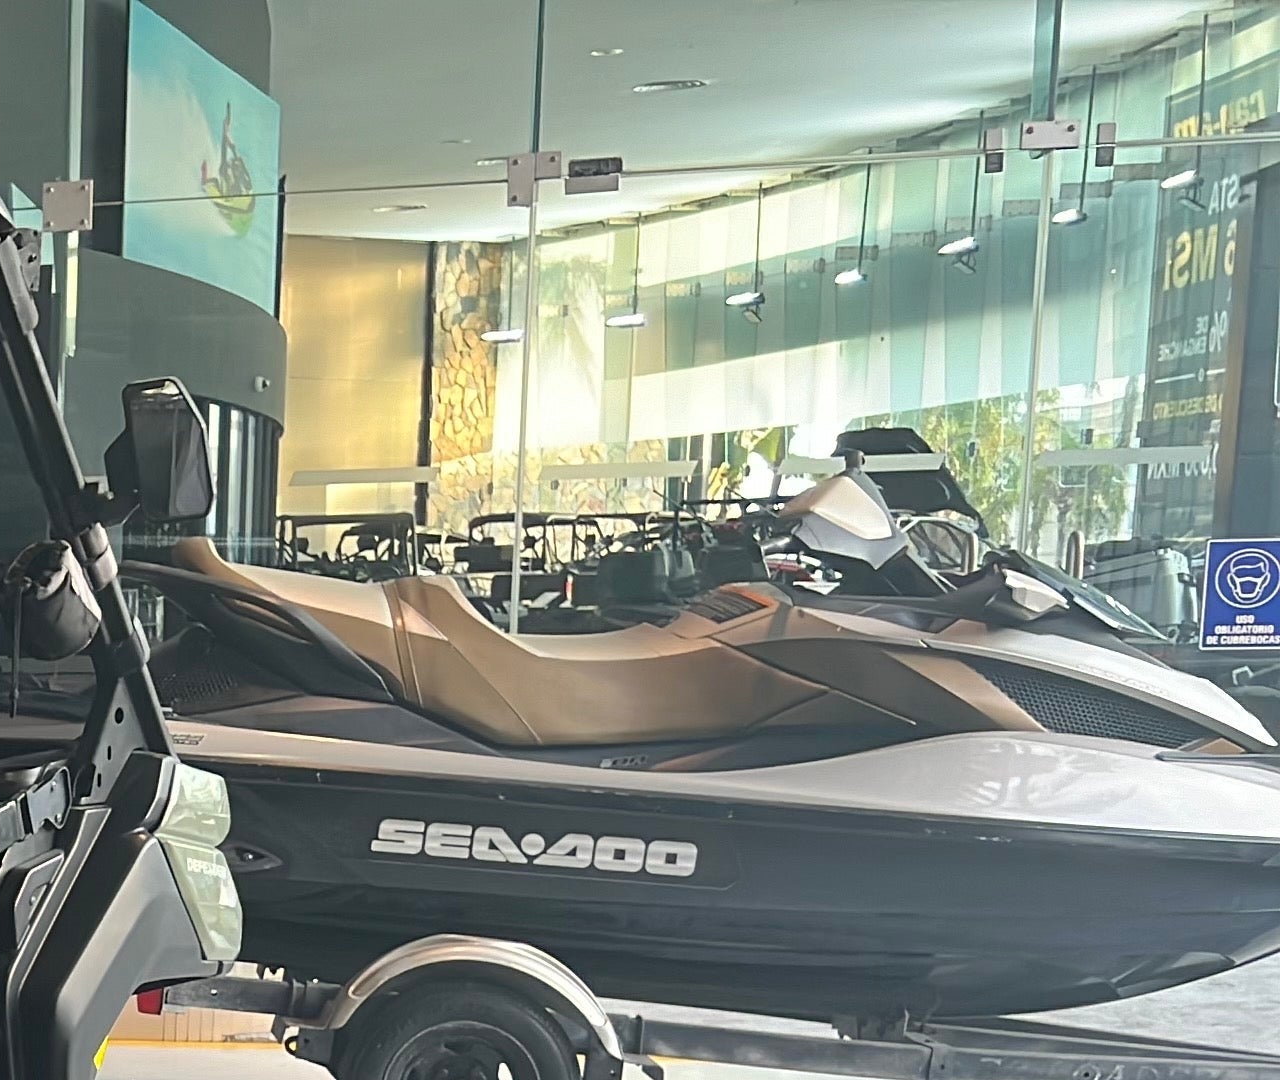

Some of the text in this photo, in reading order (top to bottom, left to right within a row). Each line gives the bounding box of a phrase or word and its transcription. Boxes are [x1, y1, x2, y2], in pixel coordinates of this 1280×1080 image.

[1236, 614, 1255, 624] USO
[1214, 625, 1275, 634] OBLIGATORIO
[1206, 636, 1218, 645] DE
